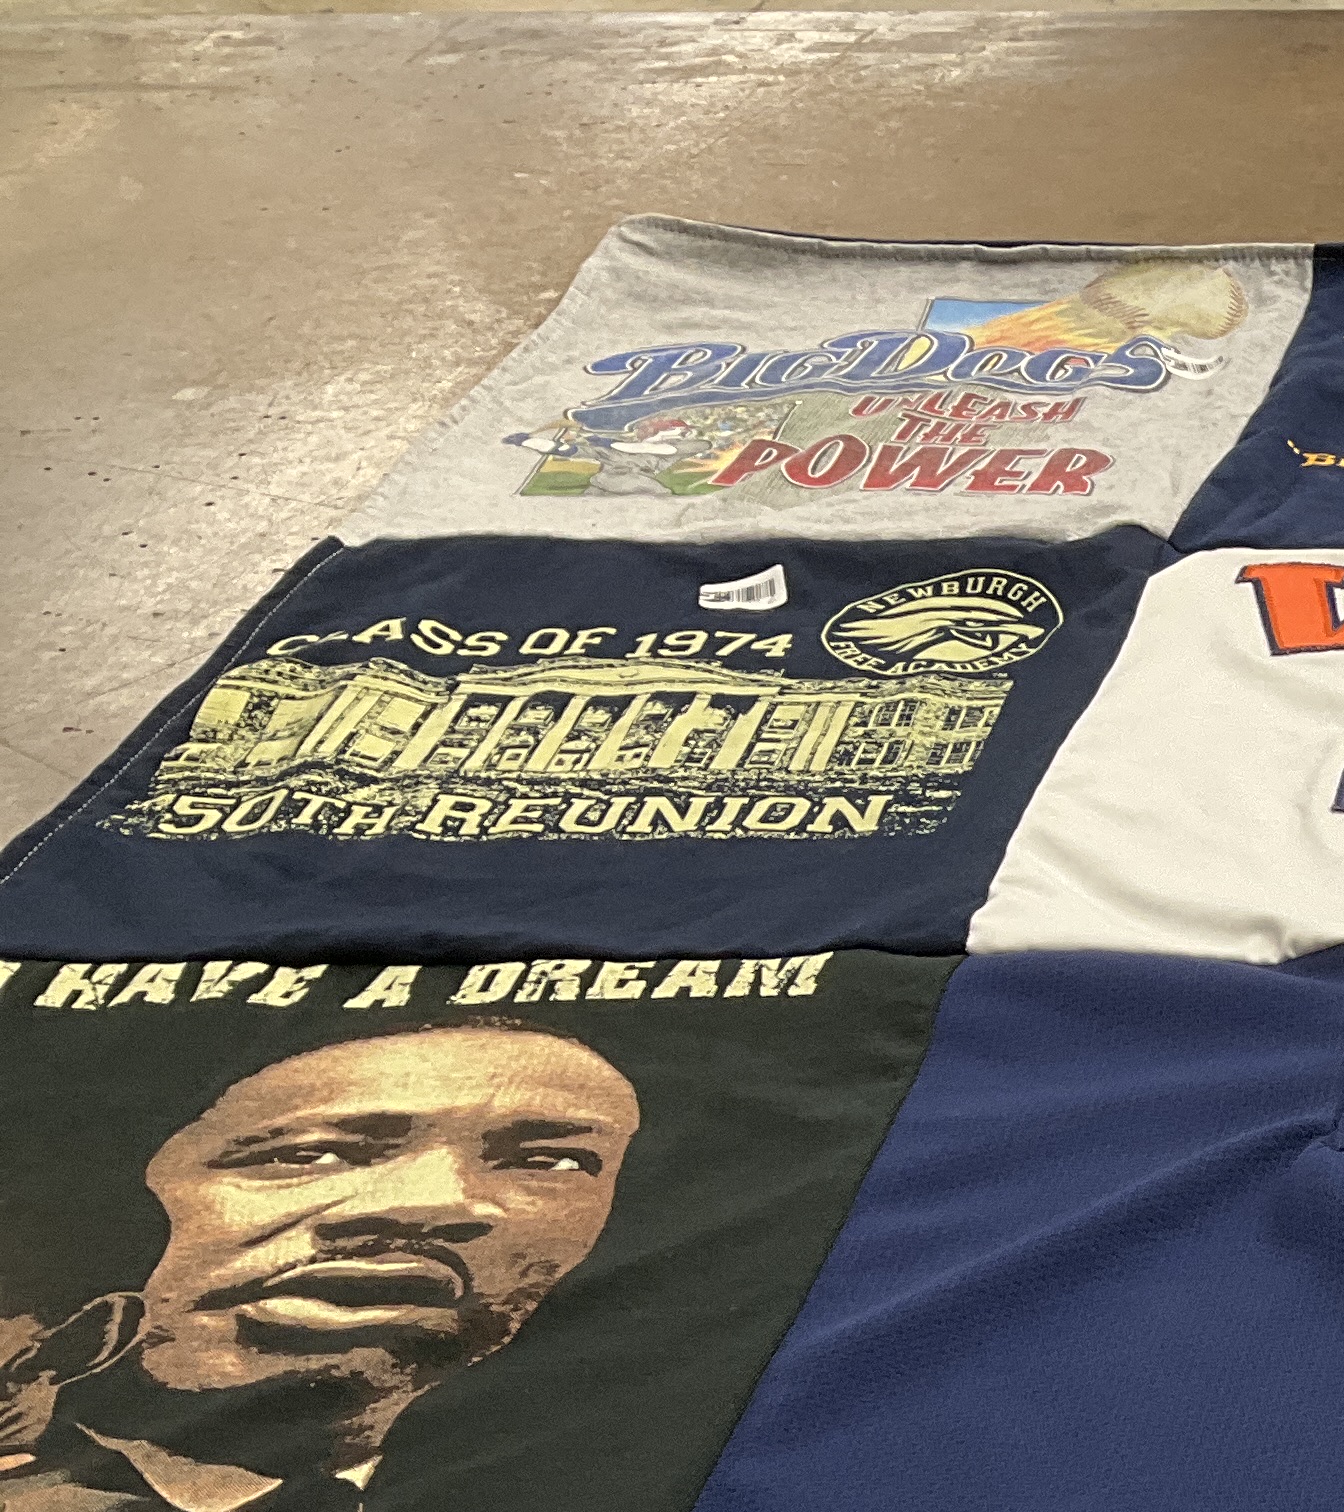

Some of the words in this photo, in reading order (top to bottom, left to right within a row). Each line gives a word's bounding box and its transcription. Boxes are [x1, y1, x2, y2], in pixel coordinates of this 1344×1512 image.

[850, 394, 1089, 426] UNLEASH
[892, 412, 990, 447] THE
[710, 433, 1116, 497] POWER
[857, 576, 1048, 613] NEWBURGH
[518, 626, 617, 658] OF
[624, 630, 792, 659] 1974
[830, 641, 886, 669] FREE
[887, 642, 1035, 675] ACADEMY
[157, 788, 400, 836] 50TH
[414, 793, 893, 838] REUNION
[33, 962, 329, 1010] HAVE
[342, 964, 411, 1009] A
[448, 951, 833, 1006] DREAM
